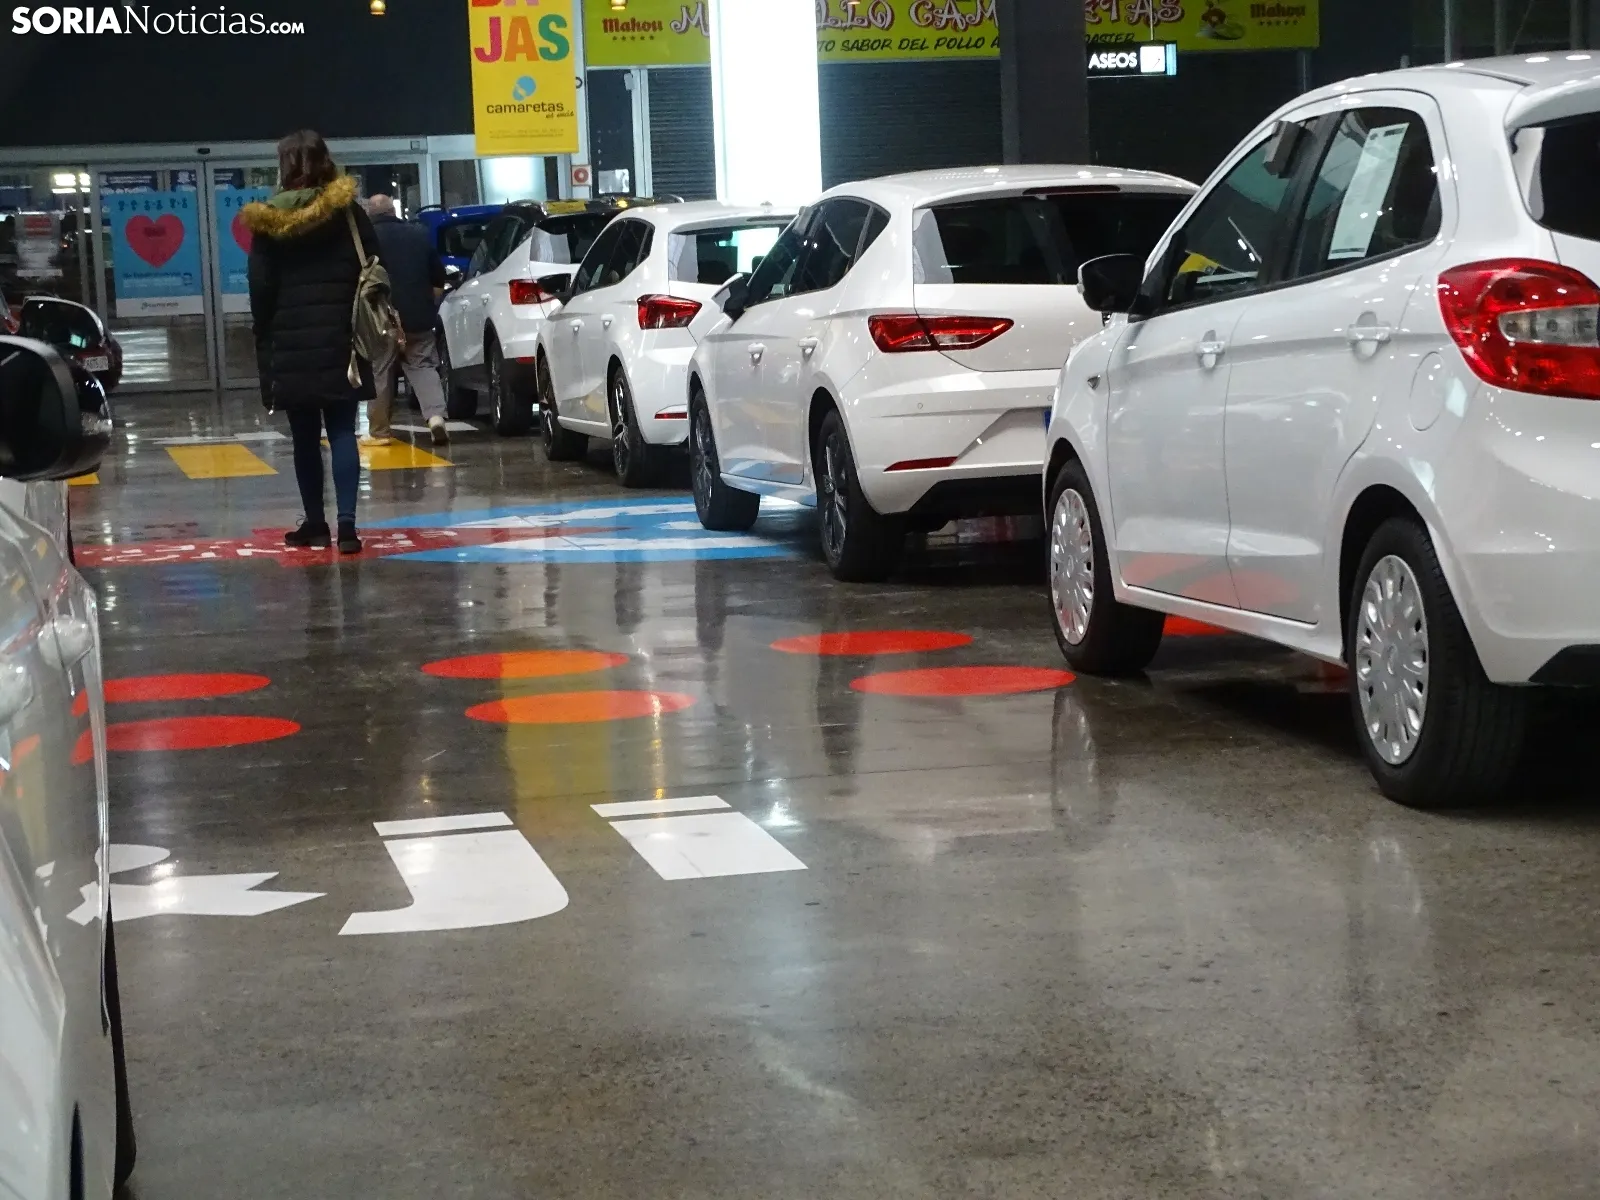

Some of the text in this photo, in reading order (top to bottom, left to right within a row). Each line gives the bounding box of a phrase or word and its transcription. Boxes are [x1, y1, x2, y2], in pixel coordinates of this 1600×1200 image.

[602, 17, 664, 33] Mahou
[473, 14, 570, 63] JAS
[817, 40, 836, 53] TO
[840, 38, 893, 52] SABOR
[898, 37, 929, 51] DEL
[934, 36, 986, 51] POLLO
[1088, 52, 1138, 70] ASEOS
[486, 101, 565, 114] camaretas
